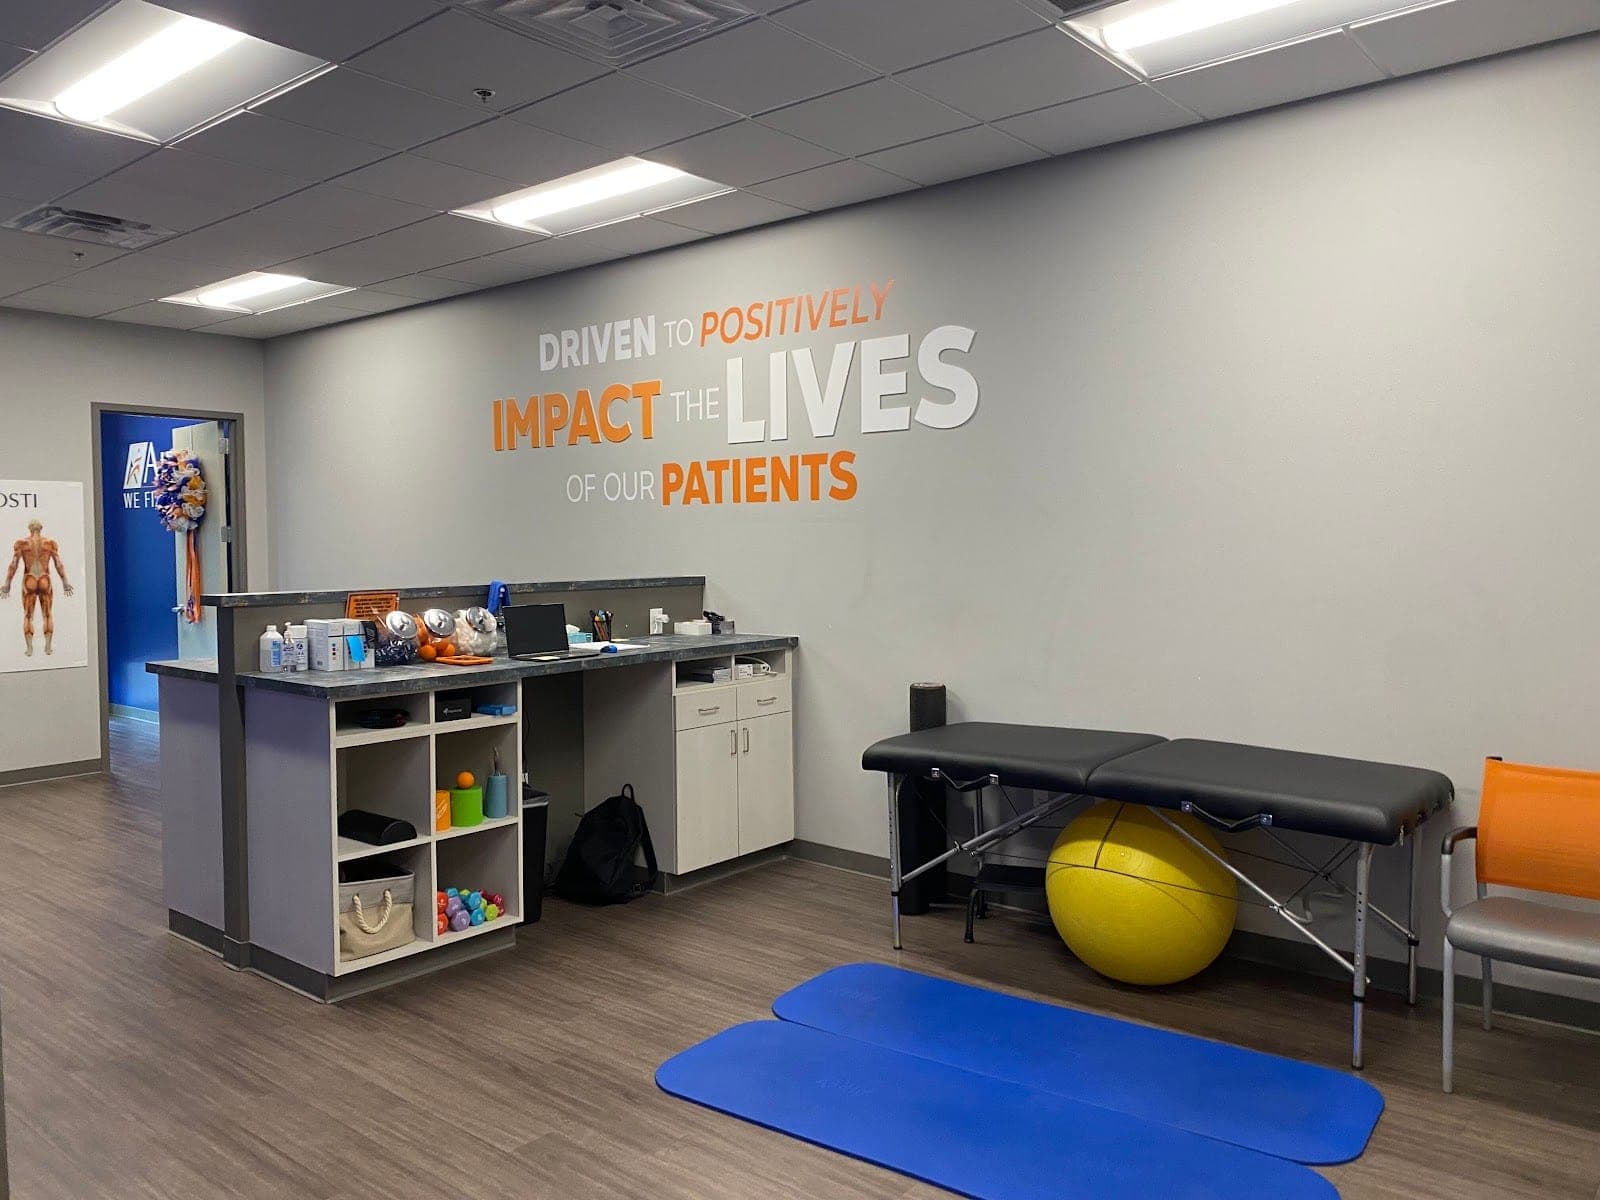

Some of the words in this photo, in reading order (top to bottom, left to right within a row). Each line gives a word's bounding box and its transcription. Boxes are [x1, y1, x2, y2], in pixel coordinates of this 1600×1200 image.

[539, 315, 656, 371] DRIVEN
[663, 318, 694, 348] TO
[700, 279, 894, 348] POSITIVELY
[493, 379, 661, 451] IMPACT
[670, 387, 721, 423] THE
[727, 325, 981, 445] LIVES
[123, 491, 140, 509] WE
[566, 474, 596, 504] OF
[603, 470, 654, 502] OUR
[662, 450, 857, 506] PATIENTS
